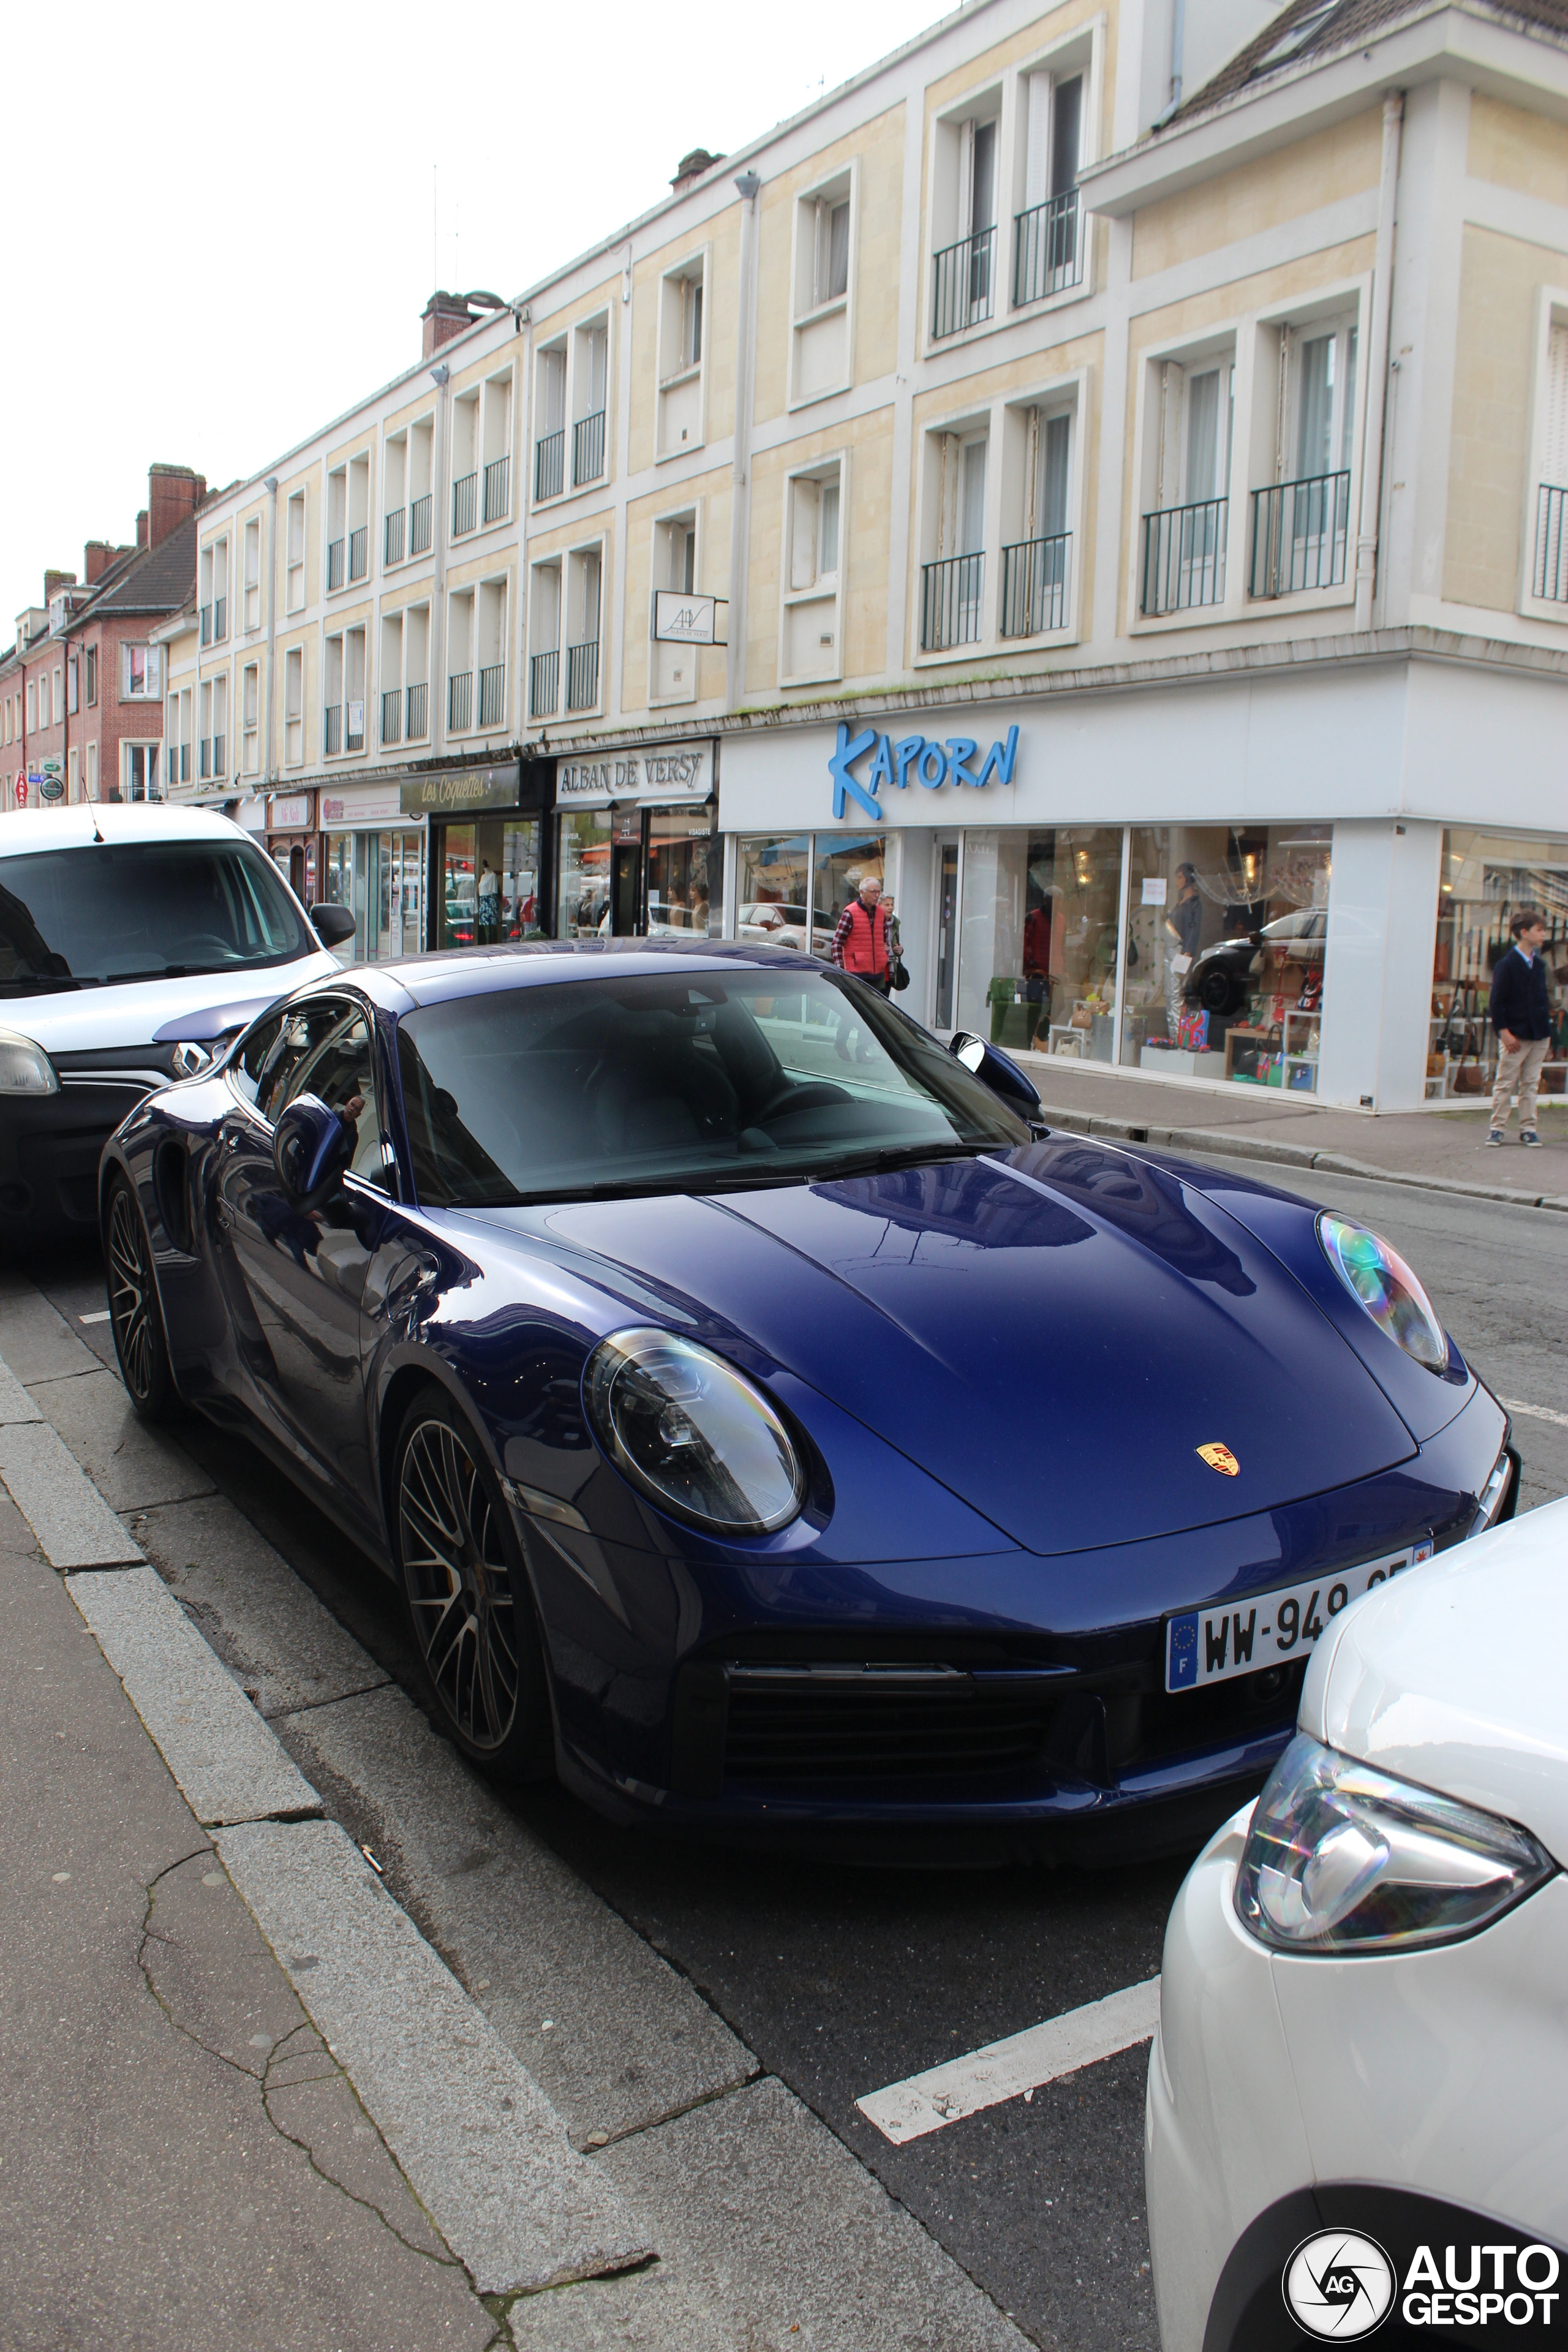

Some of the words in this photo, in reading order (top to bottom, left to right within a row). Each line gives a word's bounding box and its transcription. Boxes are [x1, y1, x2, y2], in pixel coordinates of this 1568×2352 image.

[561, 763, 613, 793] ALBAN
[615, 760, 639, 786] DE
[644, 753, 703, 788] VERSY
[828, 721, 1019, 820] KAPORN
[422, 776, 437, 802] Les
[688, 827, 711, 836] VISAGISTE
[1178, 1657, 1188, 1674] F
